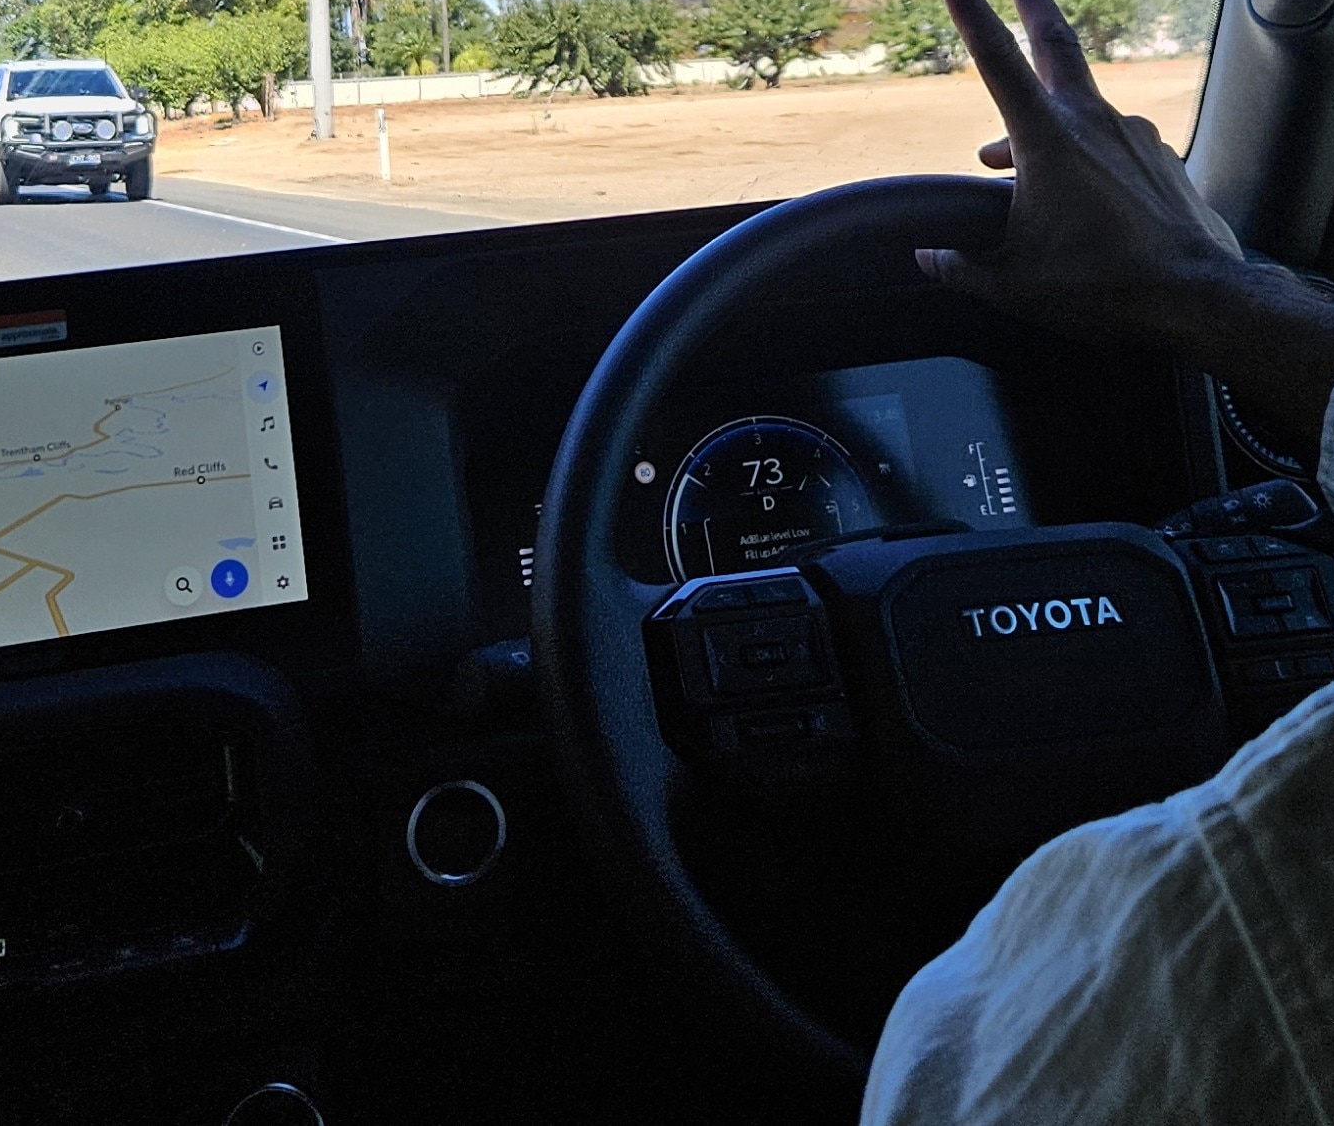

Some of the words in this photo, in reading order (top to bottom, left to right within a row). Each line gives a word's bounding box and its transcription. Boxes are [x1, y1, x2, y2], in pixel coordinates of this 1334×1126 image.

[0, 444, 46, 458] Trentham
[47, 440, 71, 453] Cliffs
[968, 443, 976, 455] F
[173, 465, 196, 477] Red
[197, 462, 226, 474] Cliffs
[703, 463, 712, 477] 2
[741, 457, 784, 488] 73
[762, 496, 775, 511] D
[980, 504, 988, 516] E
[961, 595, 1124, 638] TOYOTA
